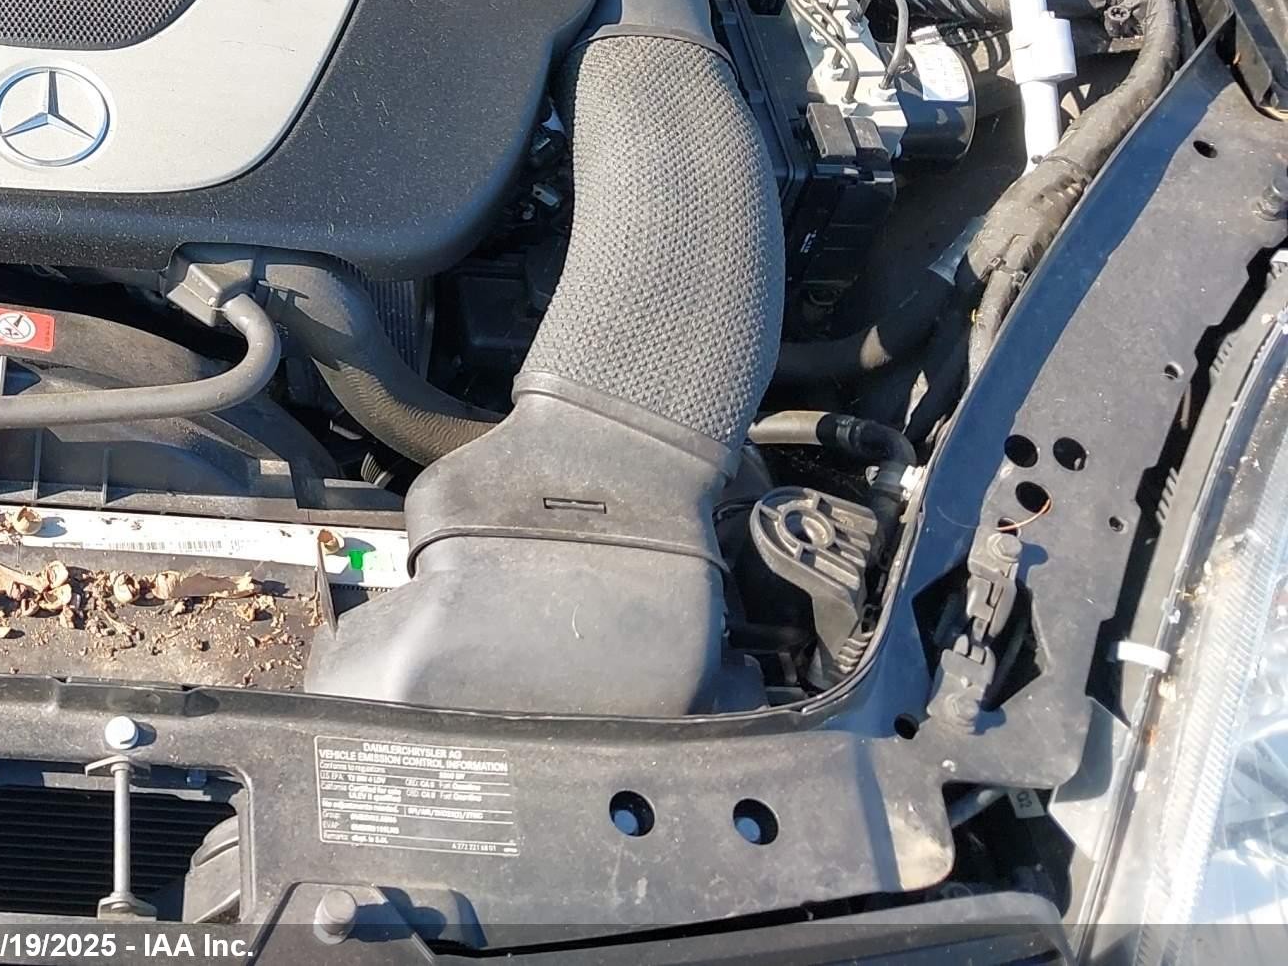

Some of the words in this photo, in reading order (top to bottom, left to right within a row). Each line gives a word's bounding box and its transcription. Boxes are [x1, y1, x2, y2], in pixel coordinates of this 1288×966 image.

[319, 749, 356, 761] VEHICLE
[358, 753, 401, 765] EMISSION
[402, 756, 444, 769] CONTROL
[446, 759, 508, 772] INFORMATION
[363, 743, 447, 758] DAIMLERCHRYSLER
[448, 750, 462, 759] AG
